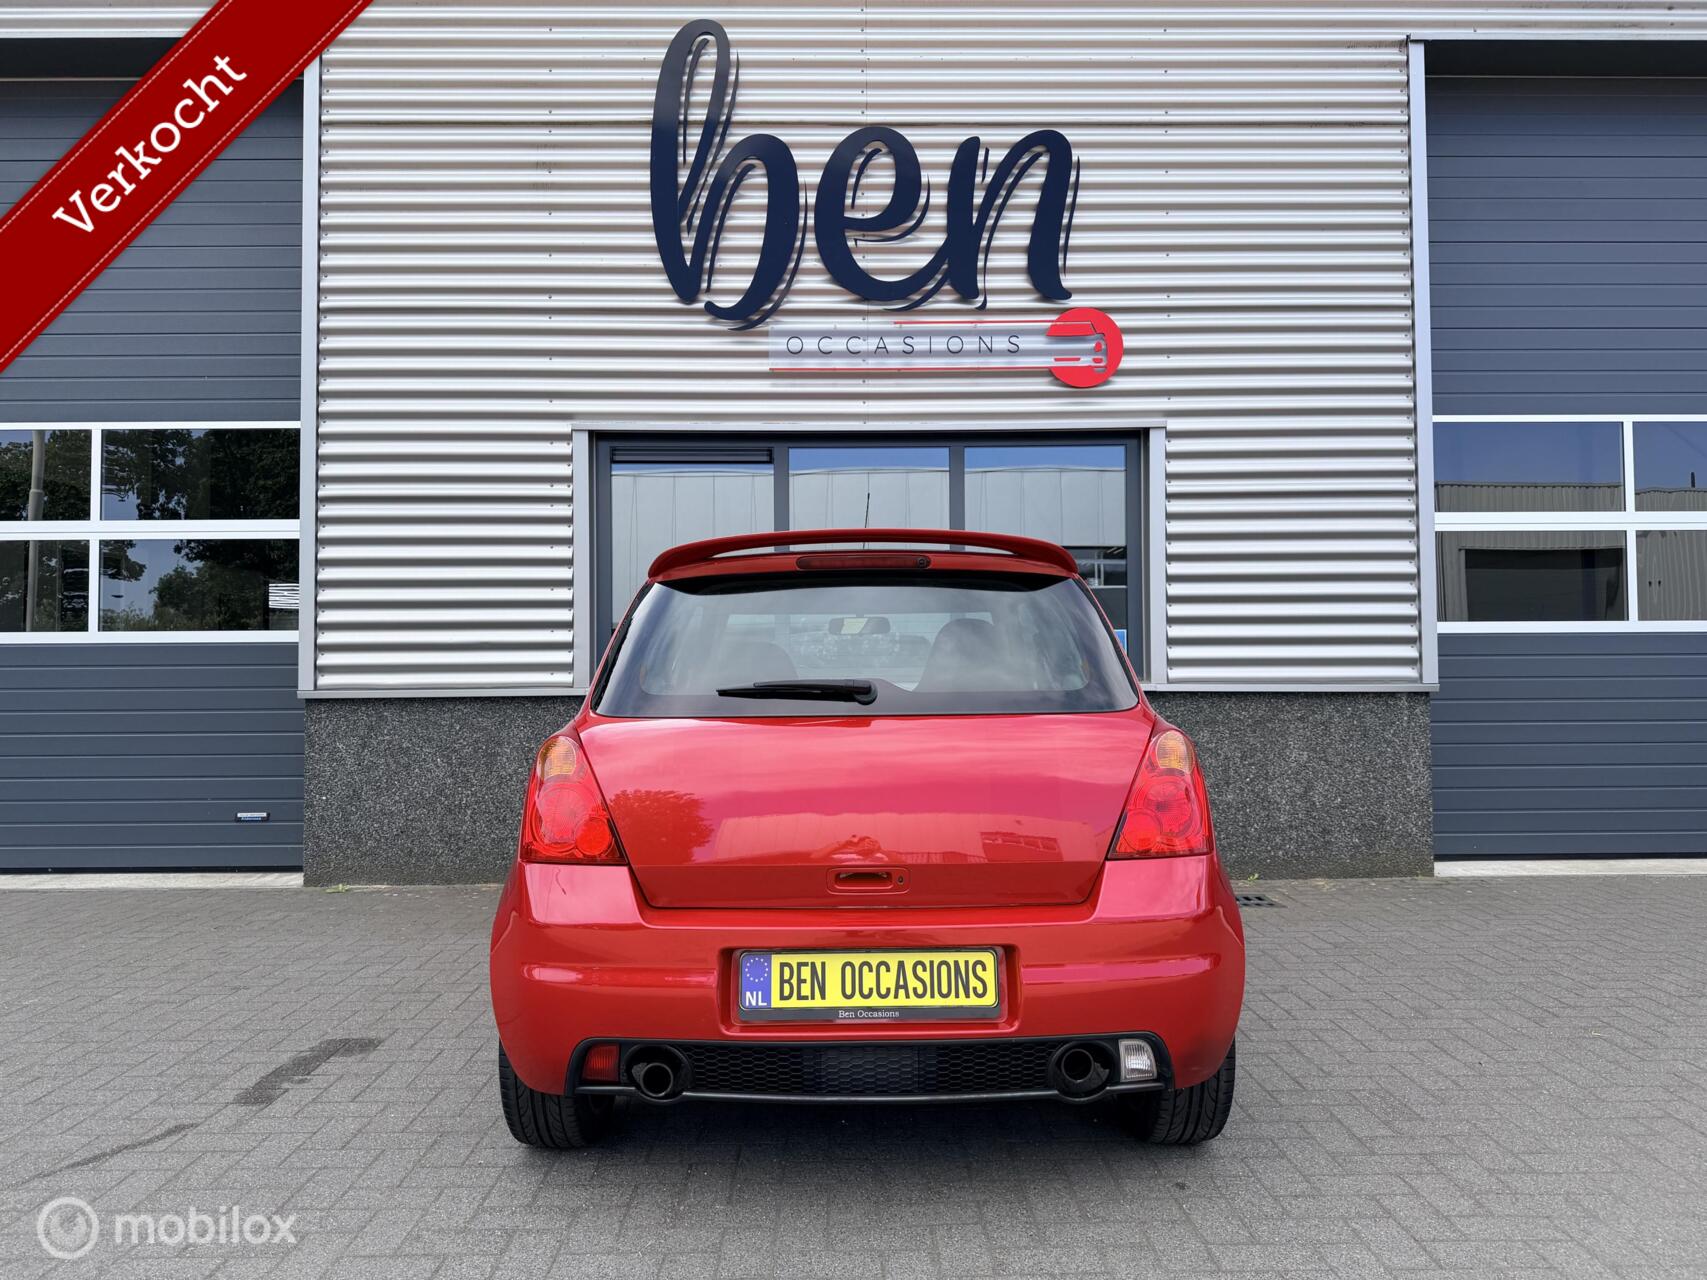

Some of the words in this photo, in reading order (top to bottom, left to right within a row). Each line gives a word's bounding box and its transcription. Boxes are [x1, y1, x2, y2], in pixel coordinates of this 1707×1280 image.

[650, 19, 1080, 331] ben
[786, 334, 1021, 355] OCCASIONS
[779, 961, 826, 1001] BEN
[840, 959, 988, 1000] OCCASIONS
[745, 991, 768, 1006] NL
[838, 1009, 855, 1018] Ben
[857, 1009, 900, 1018] Occasions
